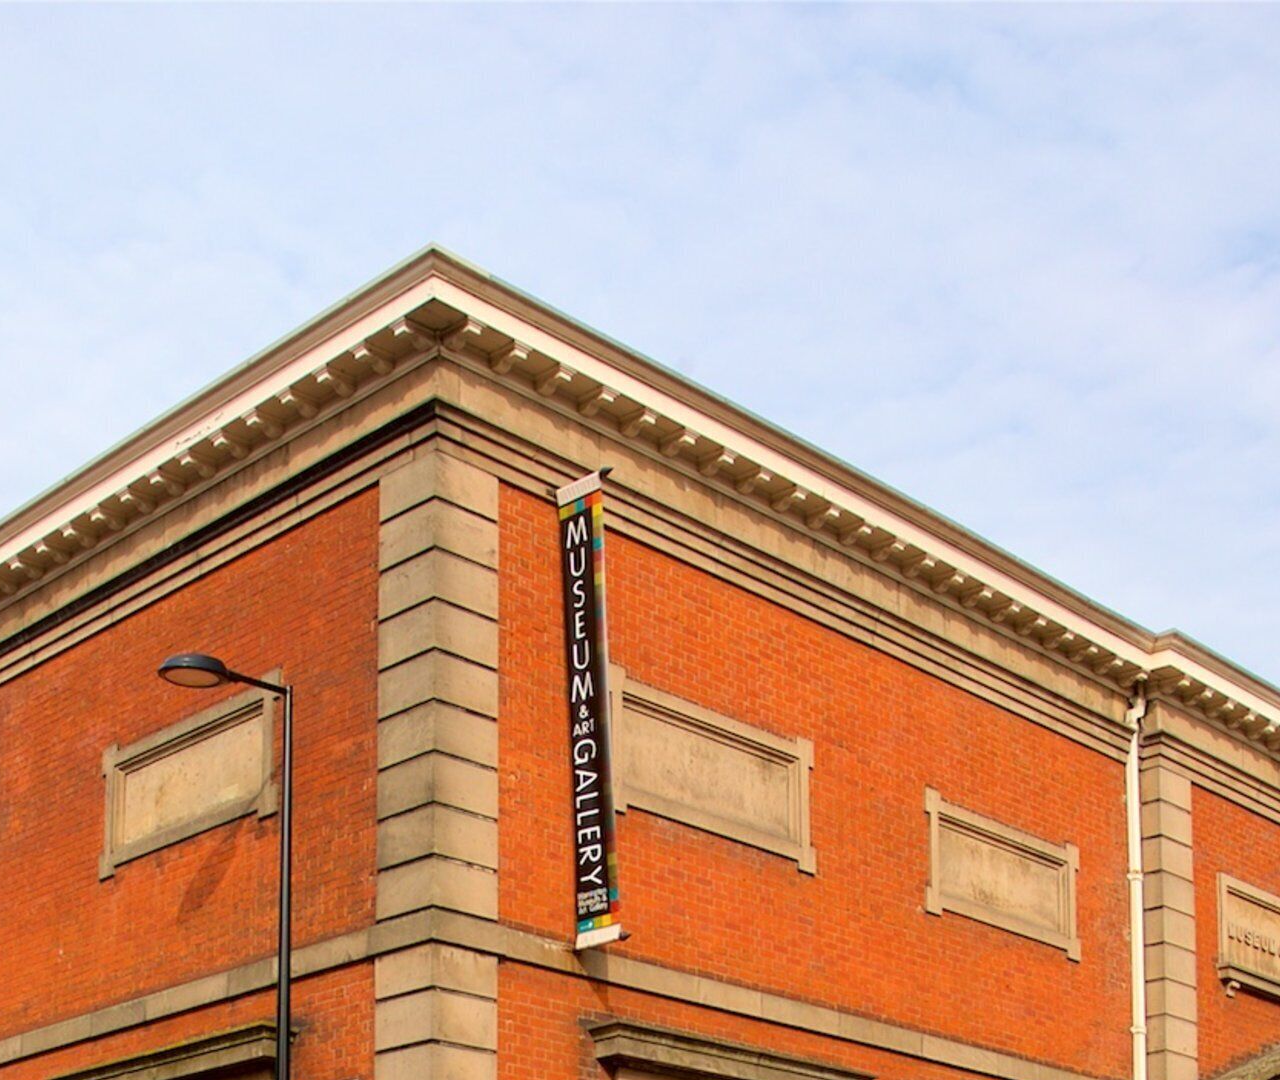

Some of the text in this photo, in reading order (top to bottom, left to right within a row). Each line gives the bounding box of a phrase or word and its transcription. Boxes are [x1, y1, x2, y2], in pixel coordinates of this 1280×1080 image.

[565, 515, 594, 704] MUSEUM
[573, 717, 595, 738] ART
[578, 704, 590, 718] &
[574, 738, 604, 885] GALLERY
